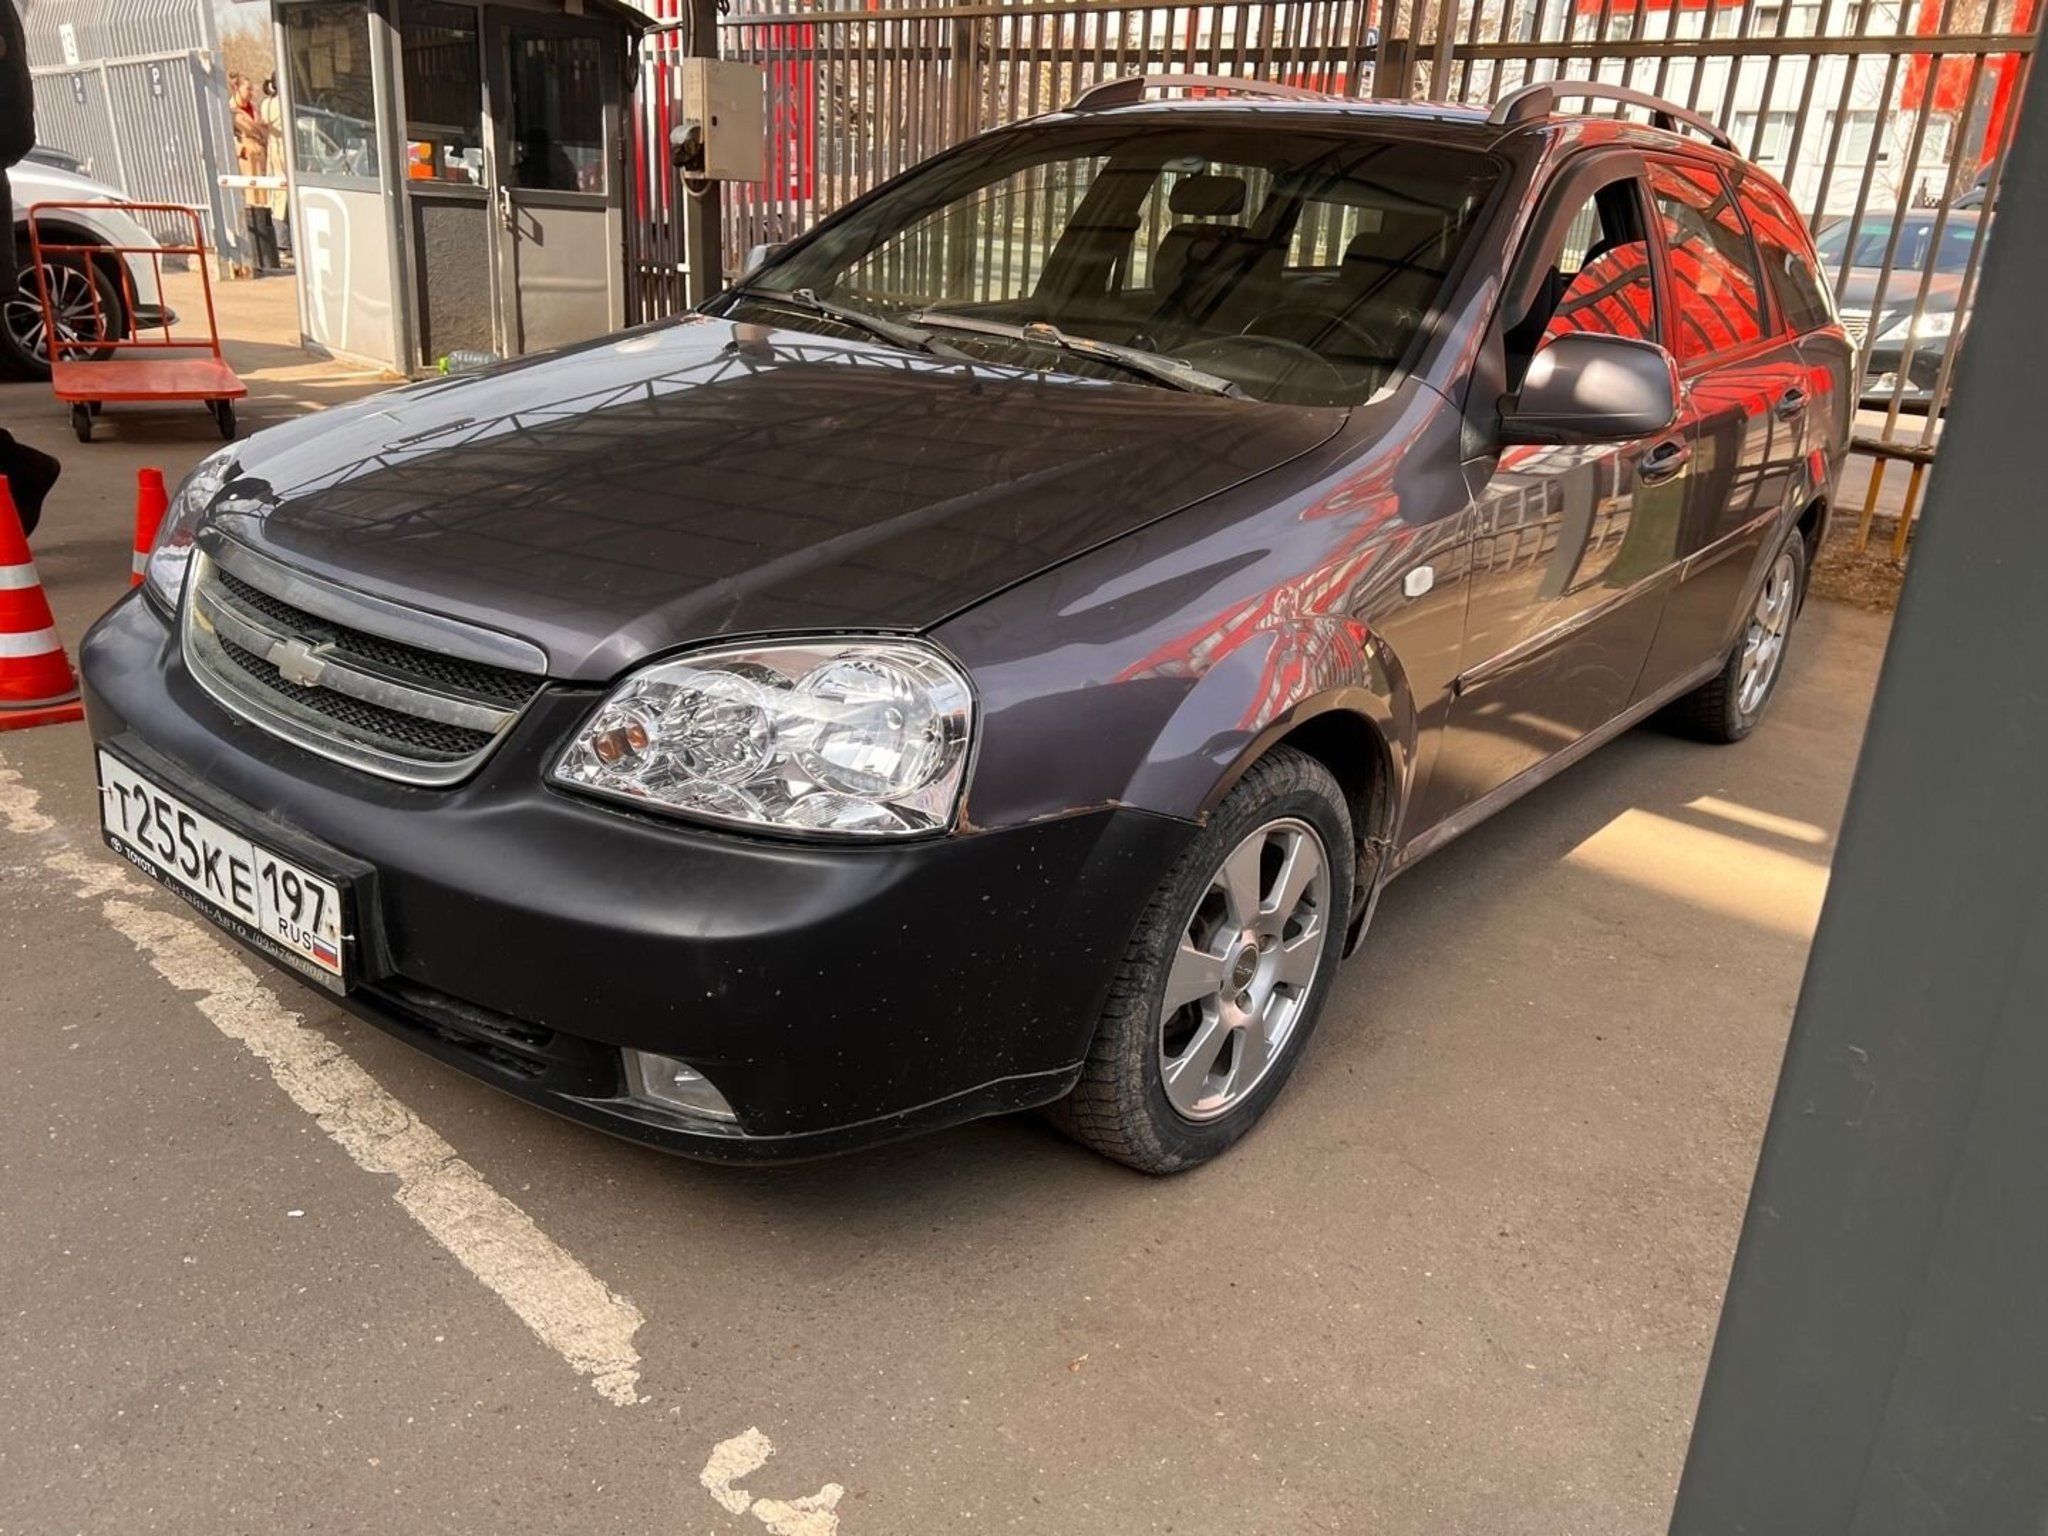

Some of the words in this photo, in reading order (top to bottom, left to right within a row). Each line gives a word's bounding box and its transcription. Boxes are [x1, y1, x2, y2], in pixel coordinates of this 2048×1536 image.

[124, 847, 158, 879] TOYOTA
[164, 876, 247, 937] Дизайн-Авто
[262, 861, 325, 933] 197
[278, 917, 312, 950] RUS
